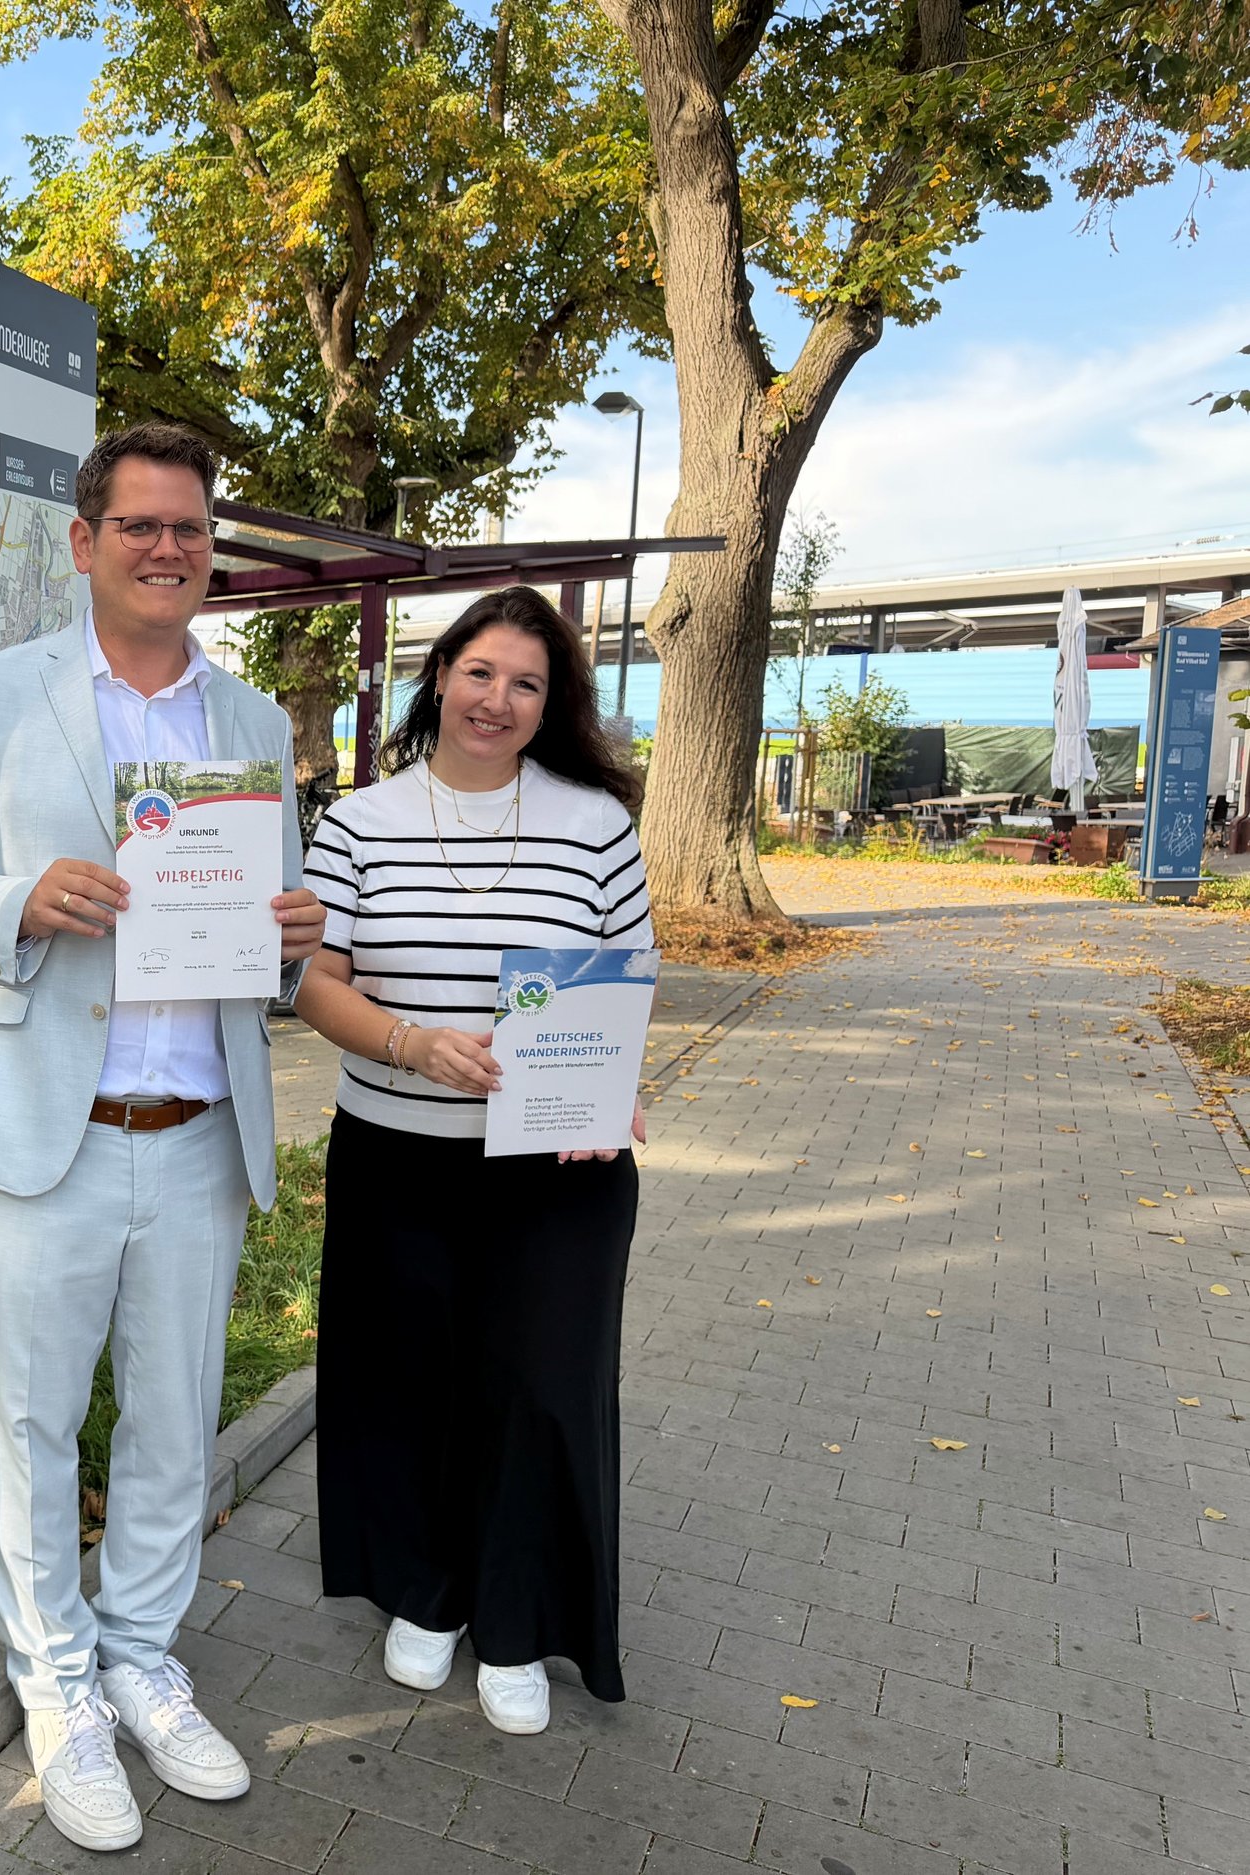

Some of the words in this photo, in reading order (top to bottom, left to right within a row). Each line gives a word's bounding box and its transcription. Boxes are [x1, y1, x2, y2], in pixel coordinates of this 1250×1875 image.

[179, 828, 219, 837] URKUNDE
[156, 868, 243, 883] VILBELSTEIG
[536, 1032, 604, 1043] DEUTSCHES
[515, 1046, 622, 1058] WANDERINSTITUT
[538, 1062, 564, 1070] gestalten
